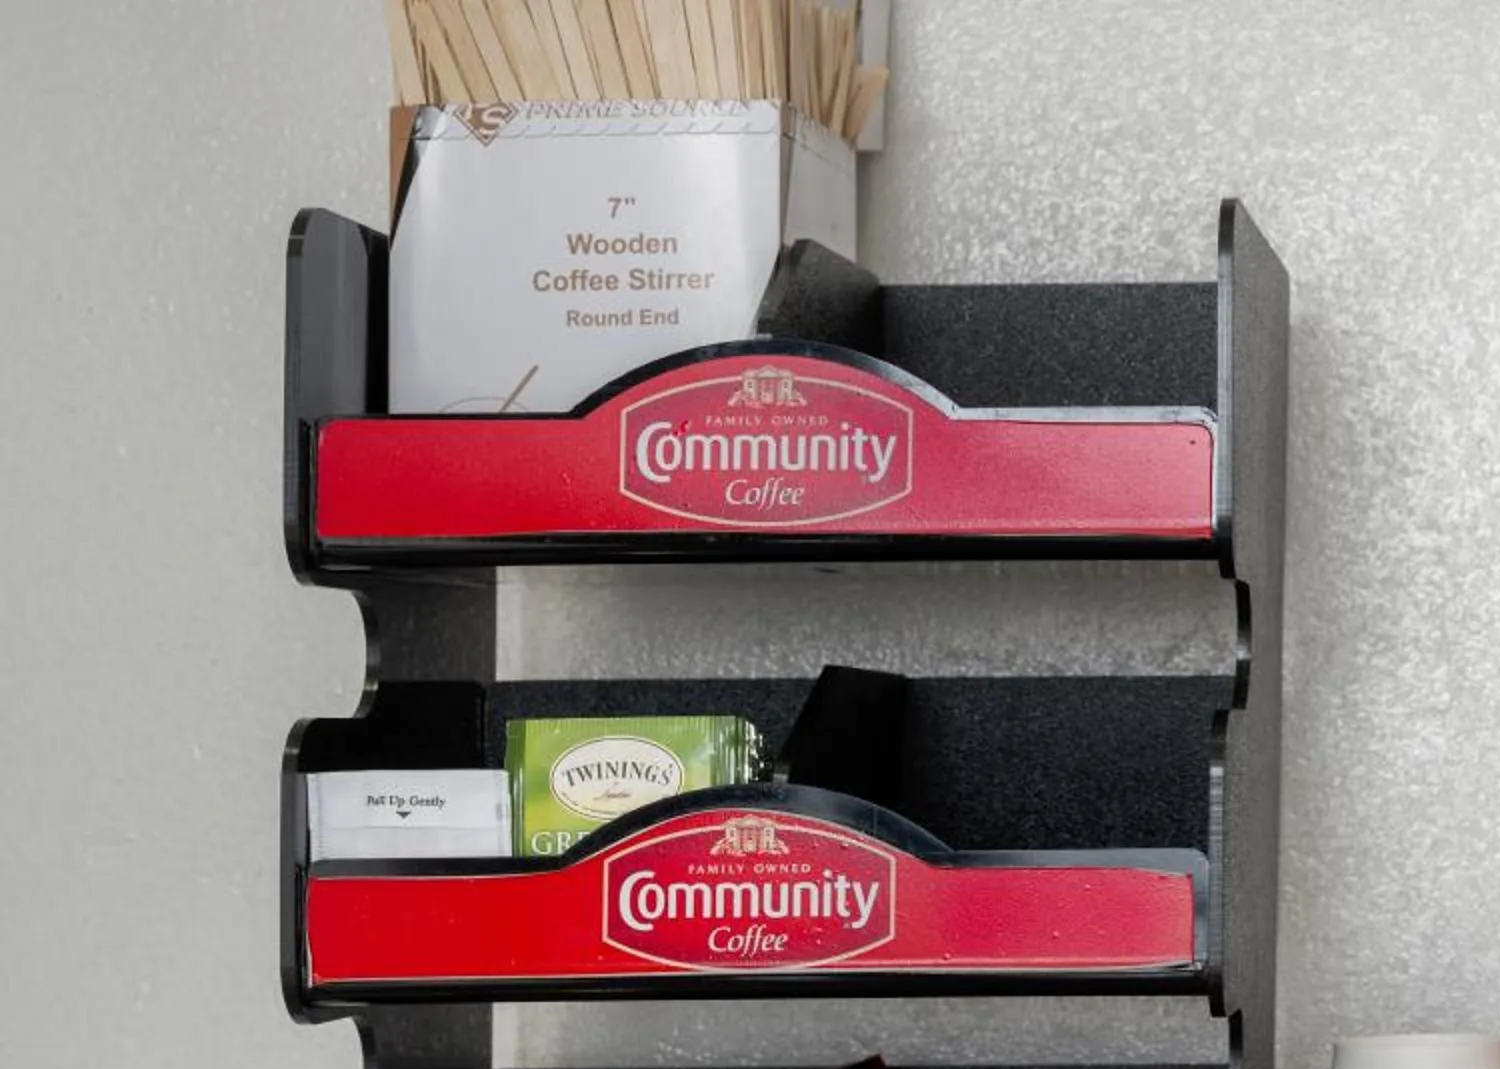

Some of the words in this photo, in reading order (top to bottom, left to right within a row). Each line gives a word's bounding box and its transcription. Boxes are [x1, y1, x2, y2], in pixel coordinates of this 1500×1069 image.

[608, 196, 636, 219] 7"
[567, 233, 679, 256] Wooden
[533, 269, 619, 292] Coffee
[629, 268, 715, 290] Stirrer
[566, 309, 633, 328] Round
[640, 308, 680, 327] End
[705, 415, 762, 427] FAMILY
[771, 414, 829, 426] OWNED
[636, 421, 896, 484] Community
[725, 478, 804, 512] Coffee
[561, 760, 674, 788] TWININGS
[688, 863, 746, 875] FAMILY
[754, 863, 812, 875] OWNED
[619, 868, 879, 931] Community
[707, 926, 789, 957] Coffee
